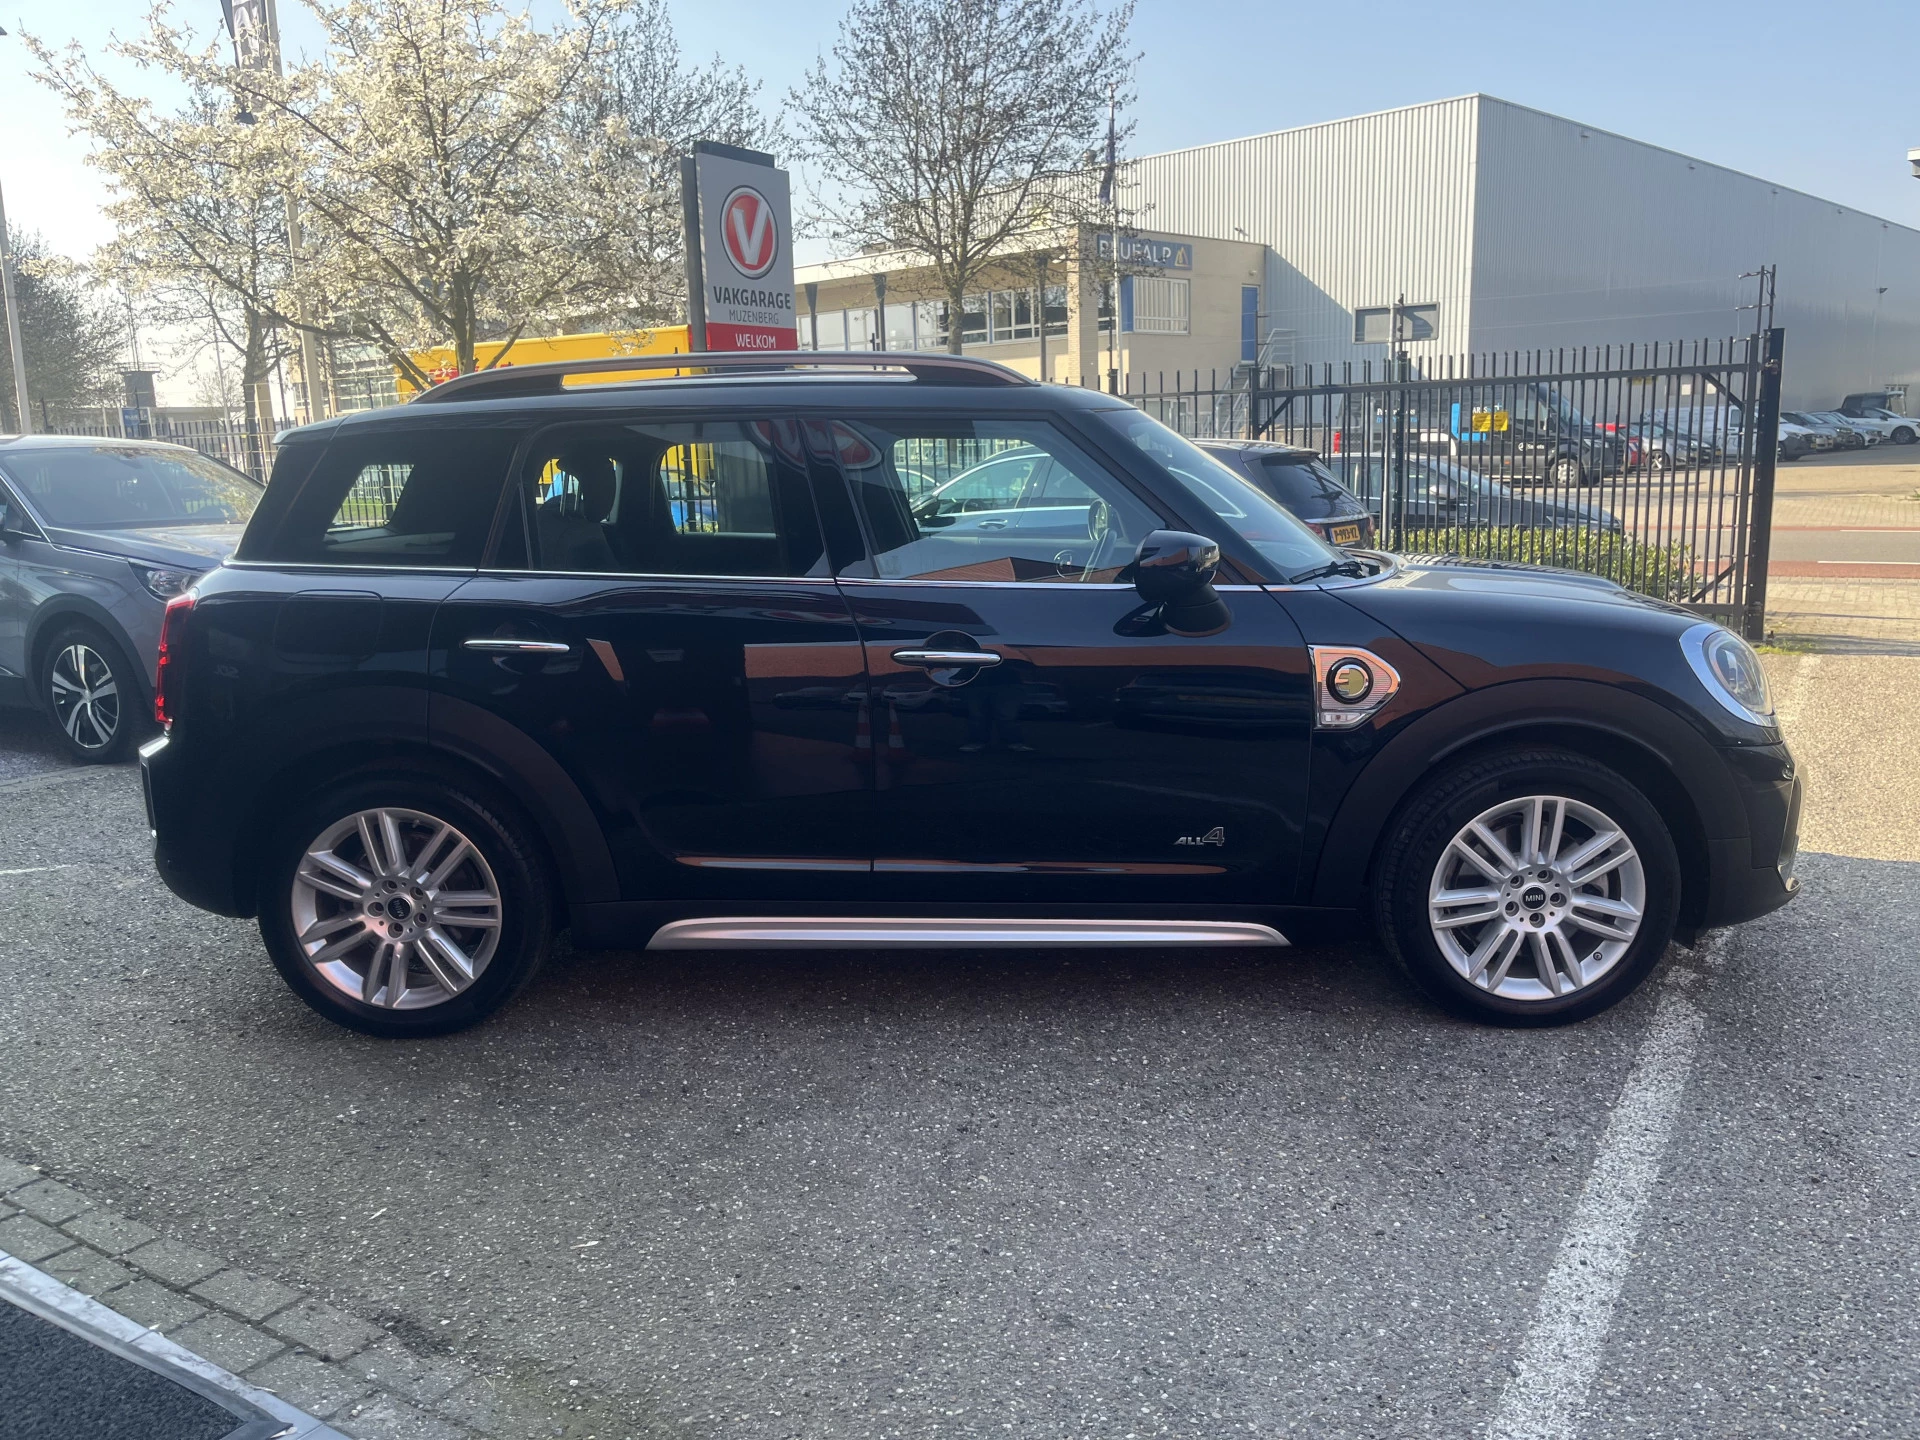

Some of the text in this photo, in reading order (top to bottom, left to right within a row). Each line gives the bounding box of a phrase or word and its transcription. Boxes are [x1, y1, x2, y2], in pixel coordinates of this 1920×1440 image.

[713, 285, 791, 310] VAKGARAGE
[729, 309, 779, 325] MUZENBERG
[735, 333, 776, 349] WELKOM
[1525, 893, 1544, 902] MINI
